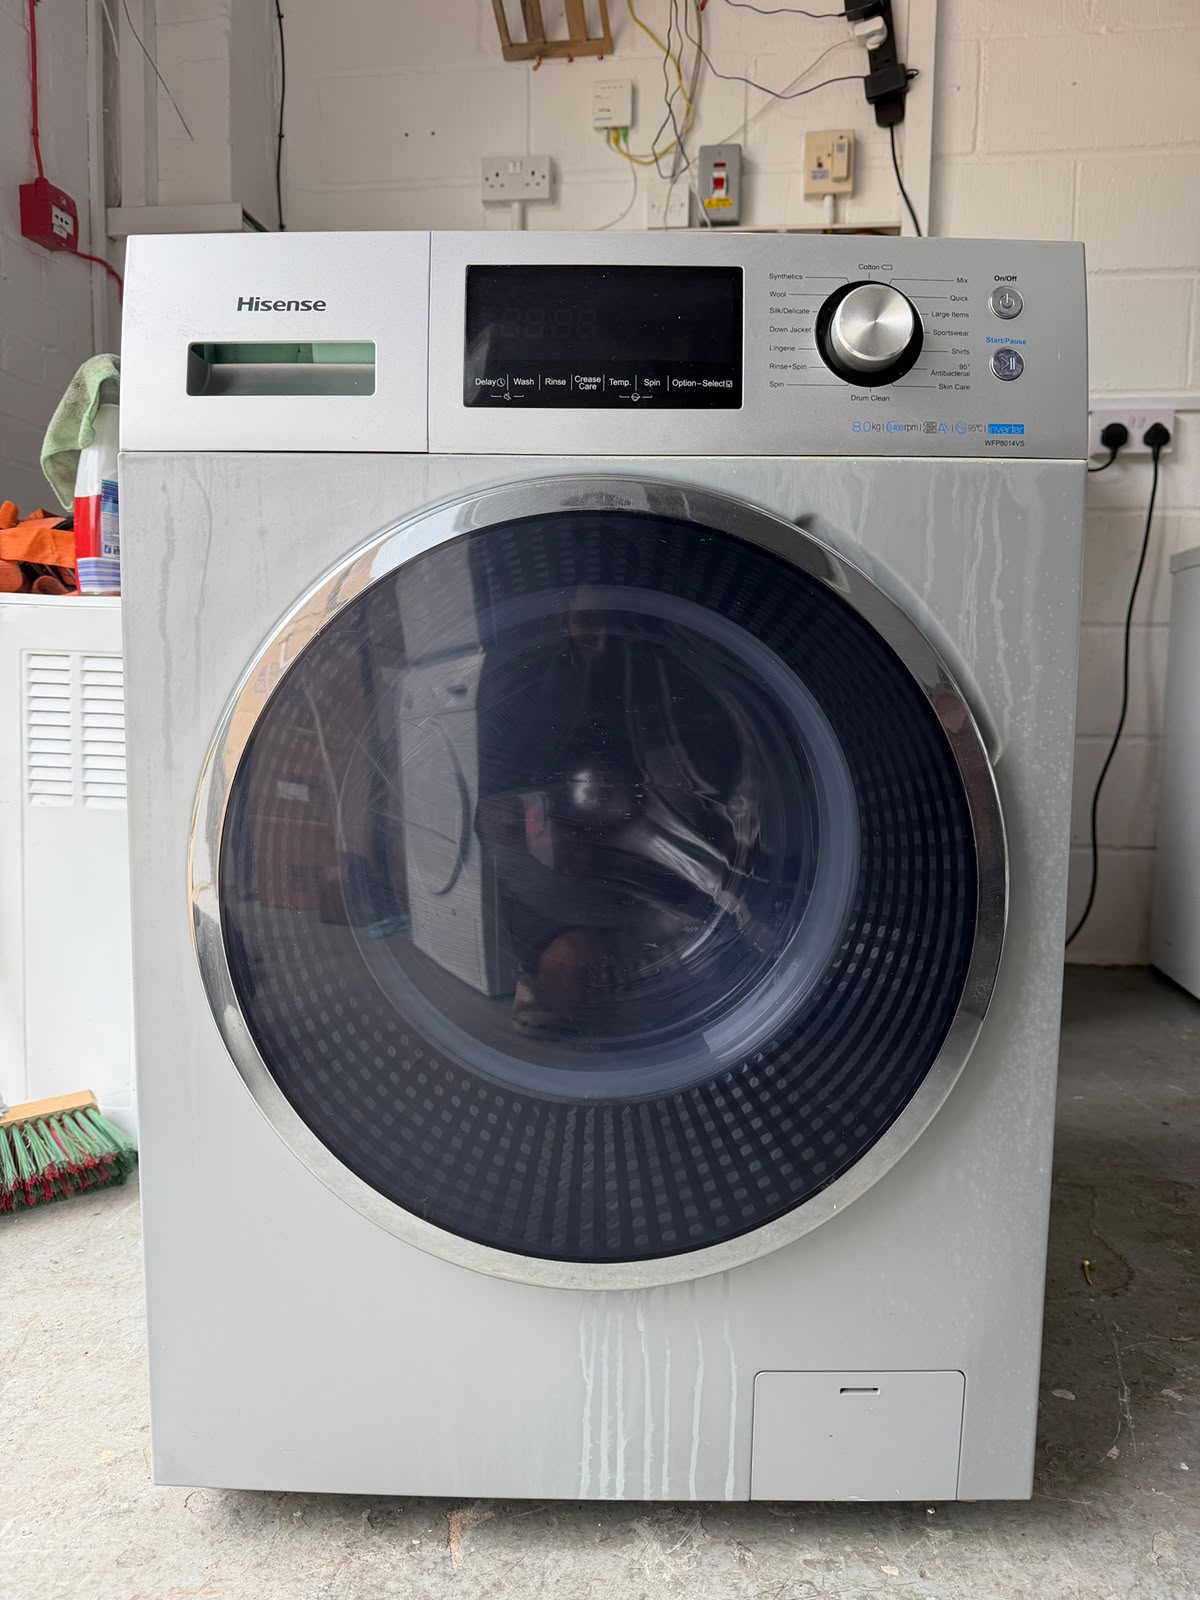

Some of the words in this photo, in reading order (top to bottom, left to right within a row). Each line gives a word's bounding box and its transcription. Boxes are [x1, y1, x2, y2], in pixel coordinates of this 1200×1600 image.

[858, 263, 880, 271] Cotton
[237, 297, 326, 311] Hisense
[769, 307, 810, 315] Silk/Delicate
[931, 311, 950, 319] Large
[790, 326, 812, 334] Jacket
[932, 329, 969, 337] Sportswear
[986, 337, 1027, 345] Start/Pause
[769, 344, 796, 353] Lingerie
[769, 363, 807, 371] Rinse+Spin
[475, 378, 497, 388] Delay
[513, 378, 535, 387] Wash
[544, 378, 567, 387] Rinse
[574, 376, 602, 384] Crease
[609, 378, 632, 388] Temp.
[643, 378, 661, 388] Spin
[578, 383, 597, 391] Care
[984, 439, 1025, 447] WFP8014VS
